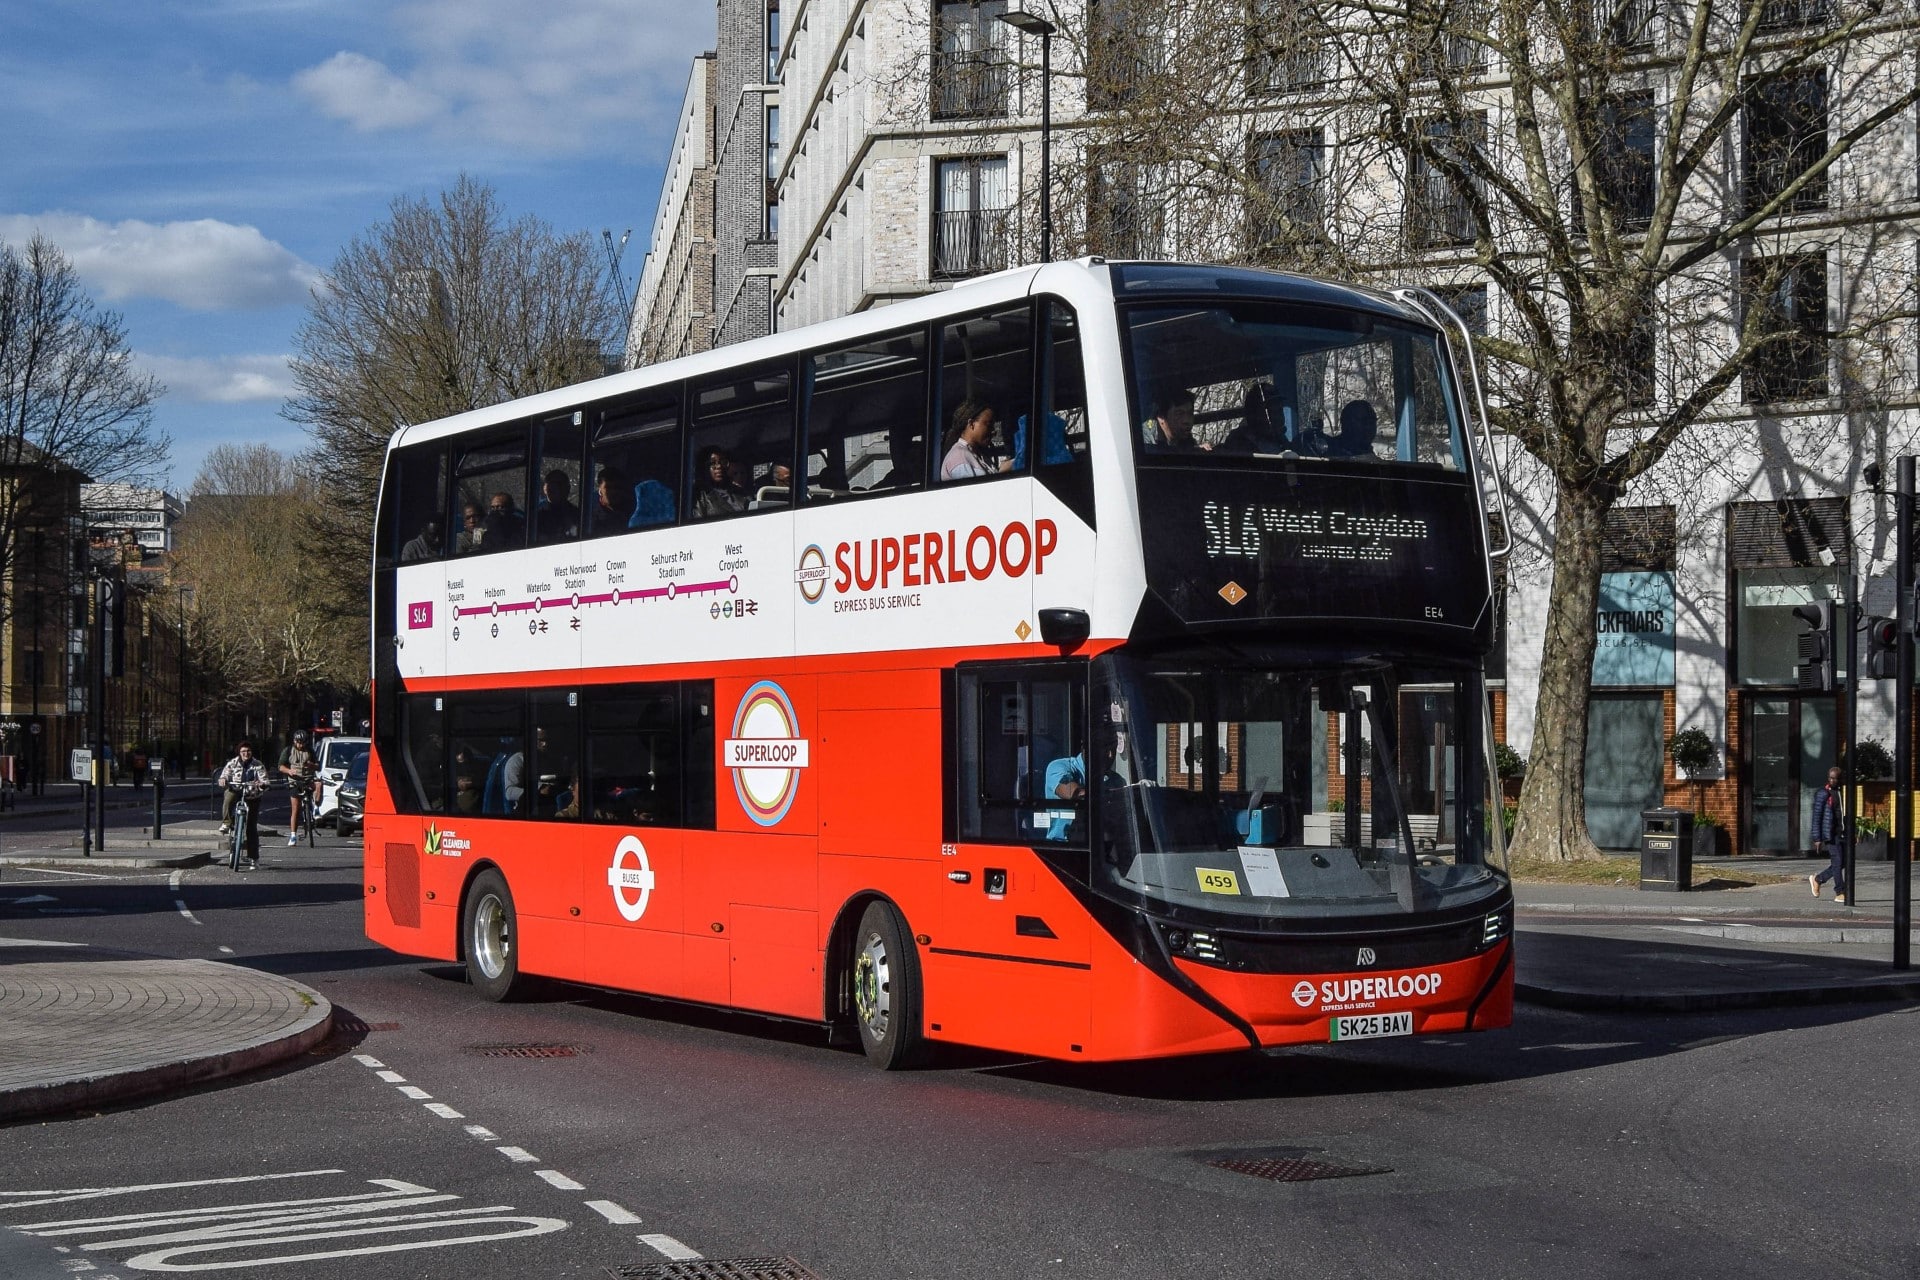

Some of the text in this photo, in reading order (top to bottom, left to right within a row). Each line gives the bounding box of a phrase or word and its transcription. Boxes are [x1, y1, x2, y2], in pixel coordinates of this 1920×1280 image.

[1203, 501, 1260, 559] SL6
[1261, 508, 1428, 546] West Croydon
[724, 544, 743, 556] West
[834, 518, 1058, 594] SUPERLOOP
[651, 549, 694, 566] Selhurst Park
[554, 562, 597, 577] West Norwood
[606, 560, 627, 571] Crown
[718, 557, 749, 573] Croydon
[608, 573, 624, 585] Point
[658, 566, 685, 579] Stadium
[799, 568, 826, 580] SUPERLOOP
[447, 579, 464, 590] Russell
[526, 582, 551, 594] Waterloo
[565, 578, 586, 590] Station
[448, 592, 465, 602] Square
[484, 588, 506, 598] Holborn
[834, 593, 921, 613] EXPRESS BUS SERVICE
[413, 608, 427, 623] SL6
[1424, 606, 1444, 619] EE4
[1597, 610, 1664, 633] CKFRIARS
[734, 744, 797, 762] SUPERLOOP
[941, 844, 957, 856] EE4
[622, 872, 640, 884] BUSES
[1205, 875, 1233, 888] 459
[1321, 973, 1442, 1003] SUPERLOOP
[1321, 1004, 1343, 1012] EXPRESS
[1340, 1014, 1409, 1037] SK25 BAV
